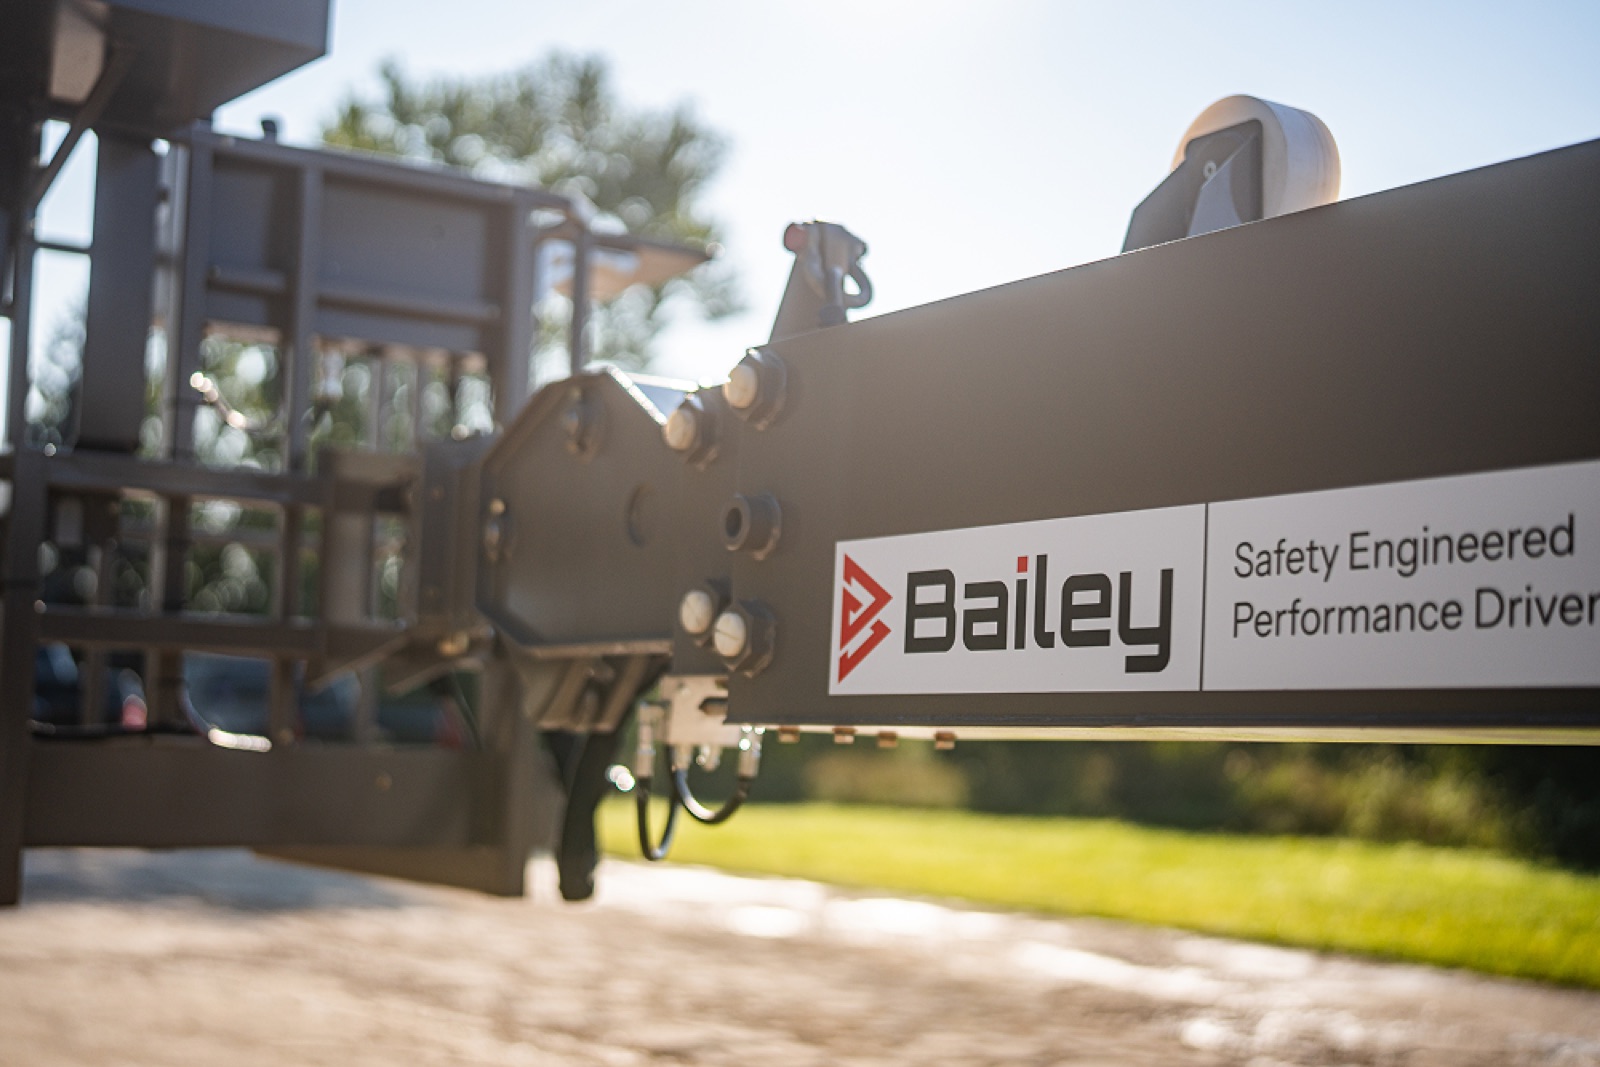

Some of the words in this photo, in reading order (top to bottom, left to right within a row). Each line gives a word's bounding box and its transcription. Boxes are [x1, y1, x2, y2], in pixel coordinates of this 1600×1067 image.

[1234, 538, 1340, 583] Safety
[1349, 511, 1577, 579] Engineered
[903, 553, 1174, 674] Bailey
[1233, 597, 1465, 639] Performance
